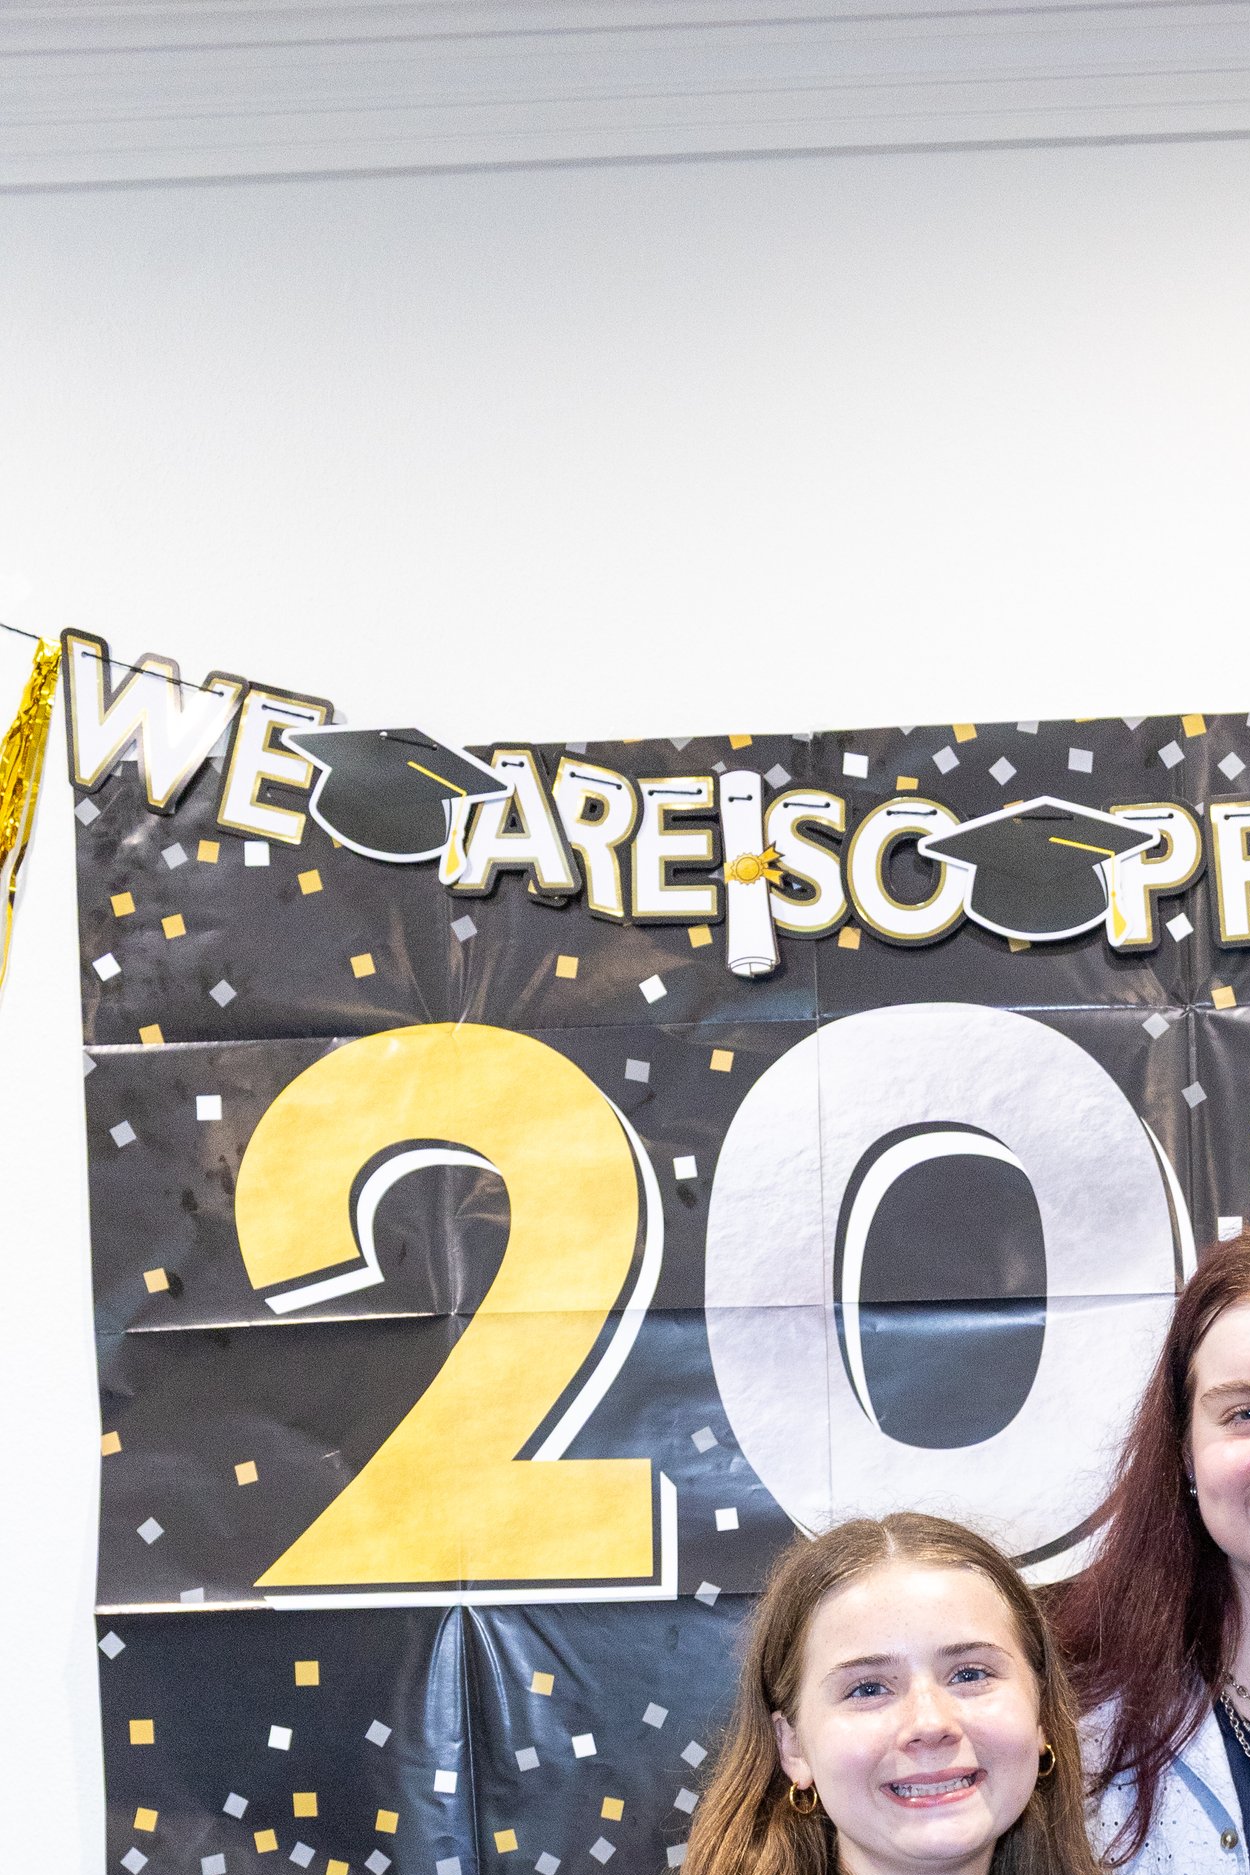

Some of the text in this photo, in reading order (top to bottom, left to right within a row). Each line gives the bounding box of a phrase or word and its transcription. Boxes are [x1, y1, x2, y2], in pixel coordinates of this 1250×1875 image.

[60, 628, 335, 846] WE
[444, 742, 726, 926] ARE
[762, 785, 970, 947] SO
